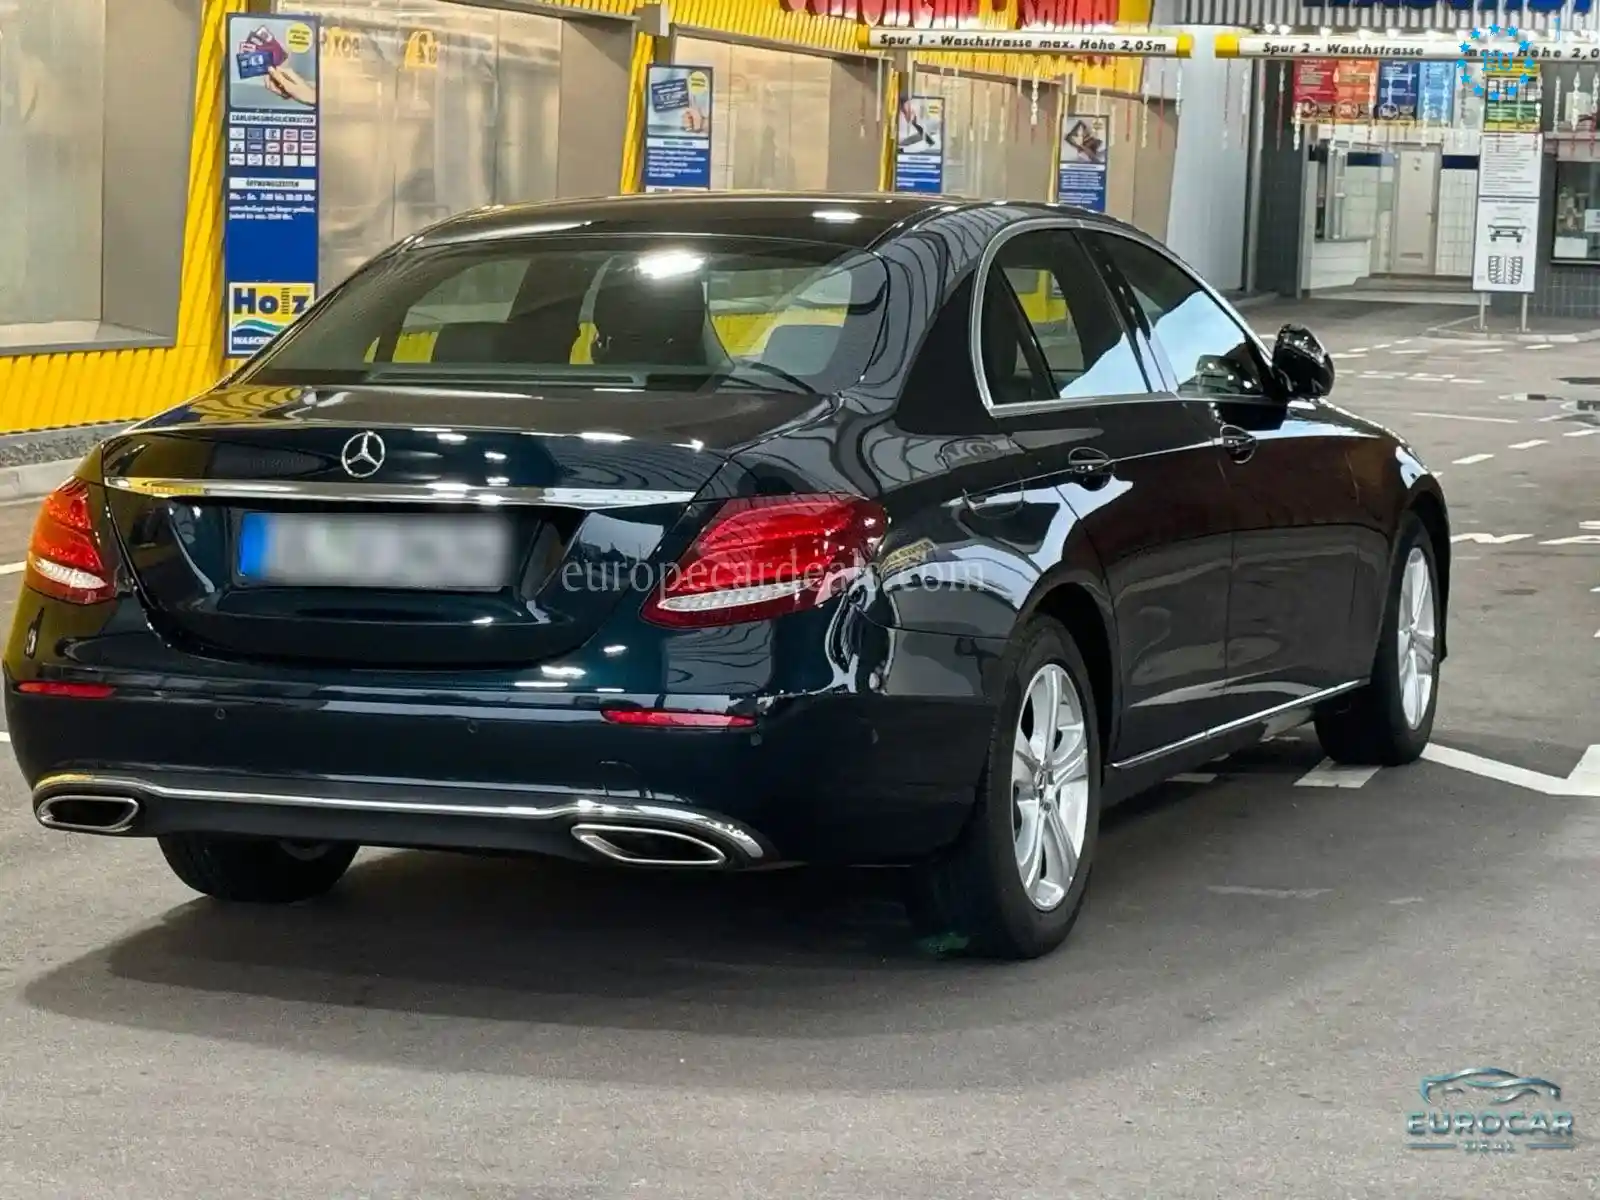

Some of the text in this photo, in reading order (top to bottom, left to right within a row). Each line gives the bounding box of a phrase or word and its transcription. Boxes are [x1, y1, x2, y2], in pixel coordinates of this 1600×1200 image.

[879, 33, 912, 47] Spur
[917, 34, 924, 46] 1
[940, 34, 1035, 48] Waschstrasse
[1038, 39, 1075, 49] max.
[1119, 40, 1167, 52] 2,05m
[1262, 42, 1296, 56] Spur
[1300, 43, 1311, 54] 2
[1327, 43, 1425, 56] Waschstrasse
